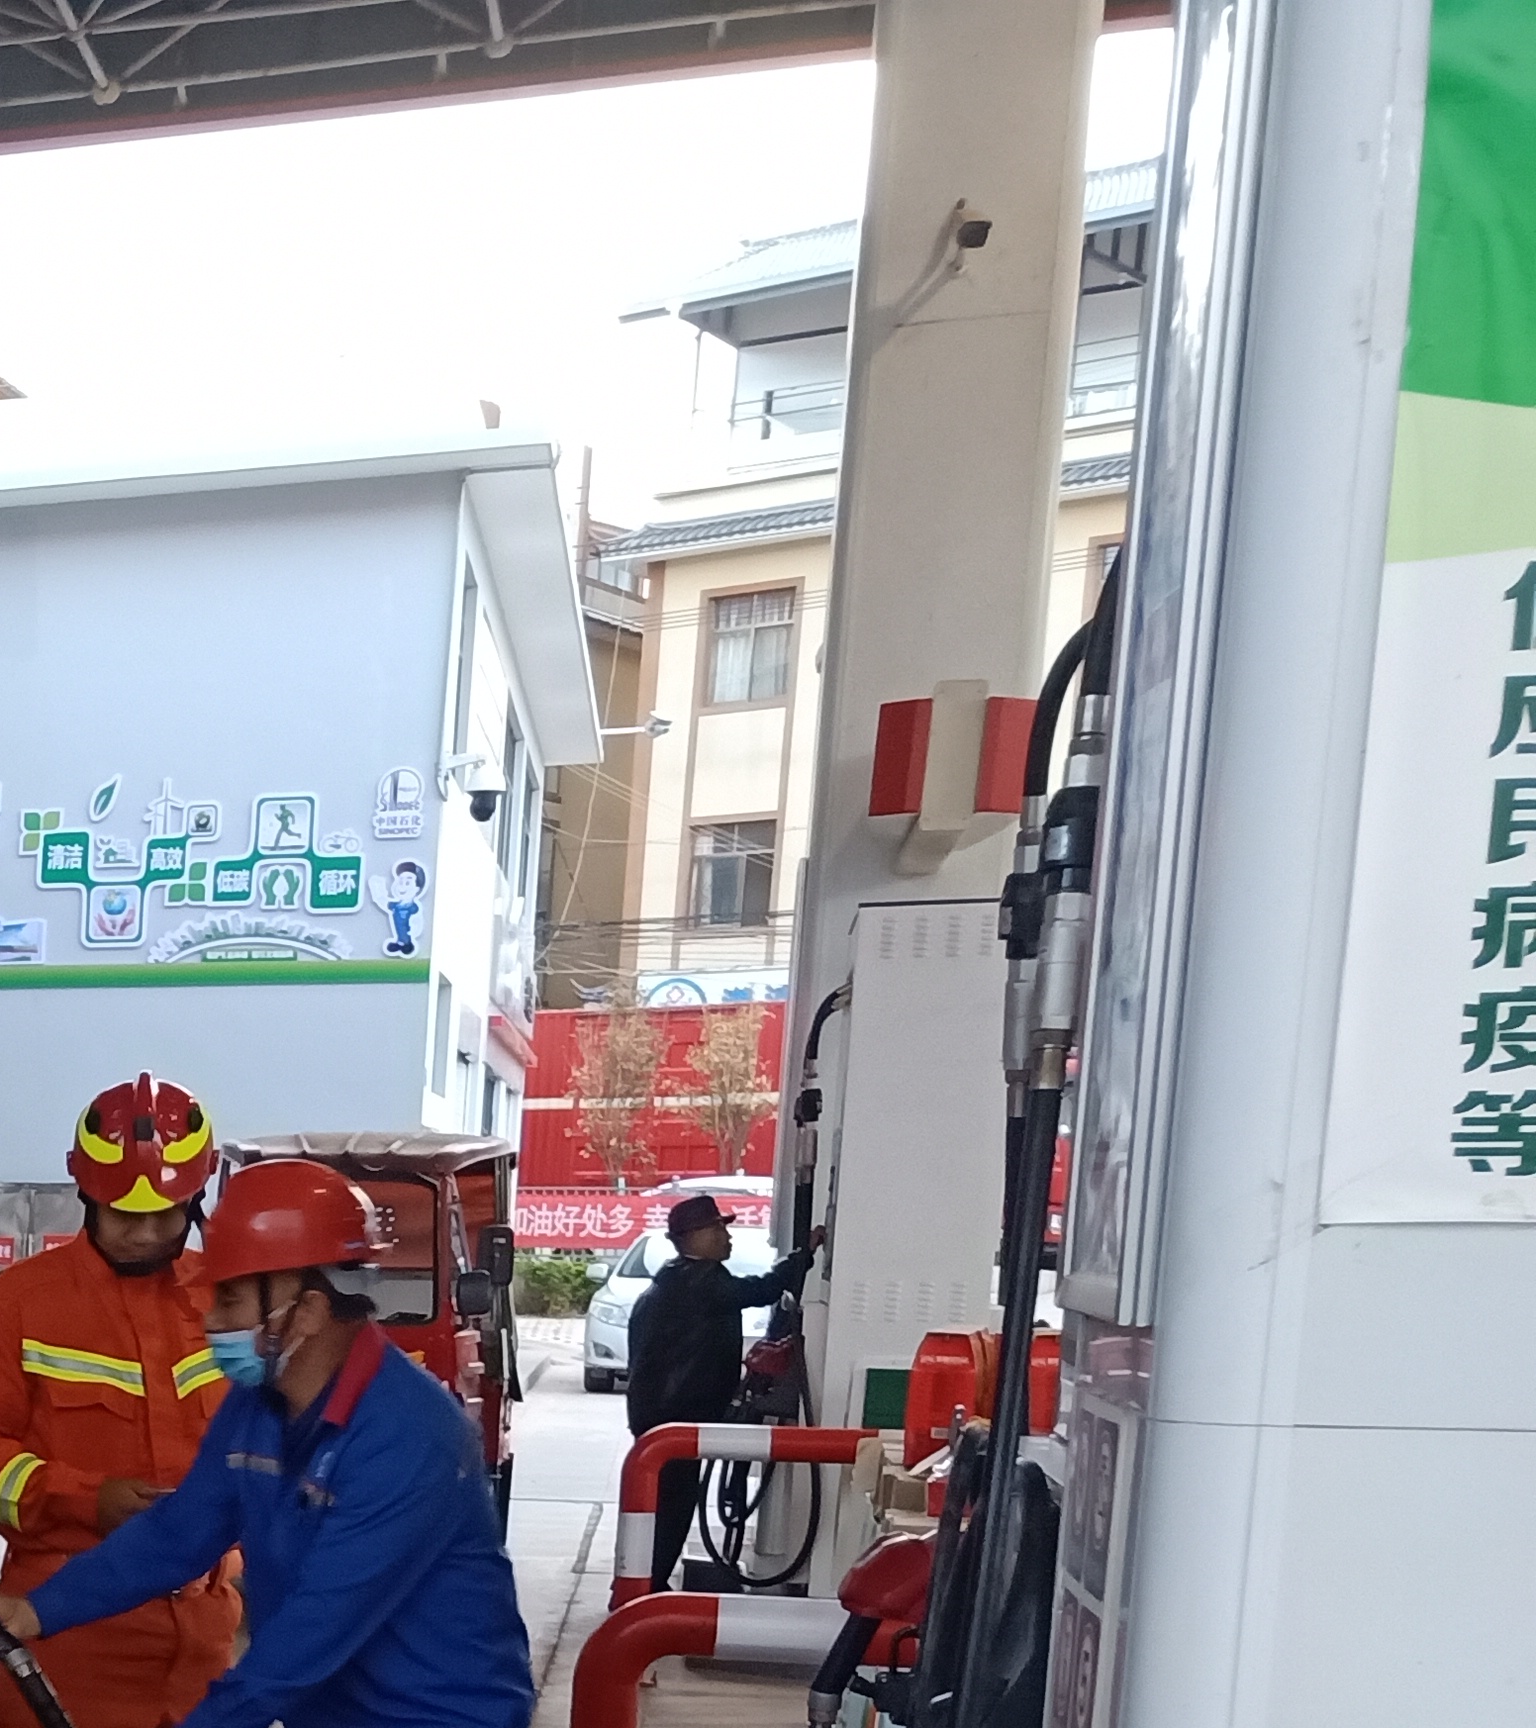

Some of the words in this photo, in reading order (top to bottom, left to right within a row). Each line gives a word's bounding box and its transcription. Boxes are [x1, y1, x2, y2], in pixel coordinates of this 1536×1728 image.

[47, 843, 84, 870] 清洁
[149, 846, 184, 871] 高效
[318, 869, 357, 896] 循环
